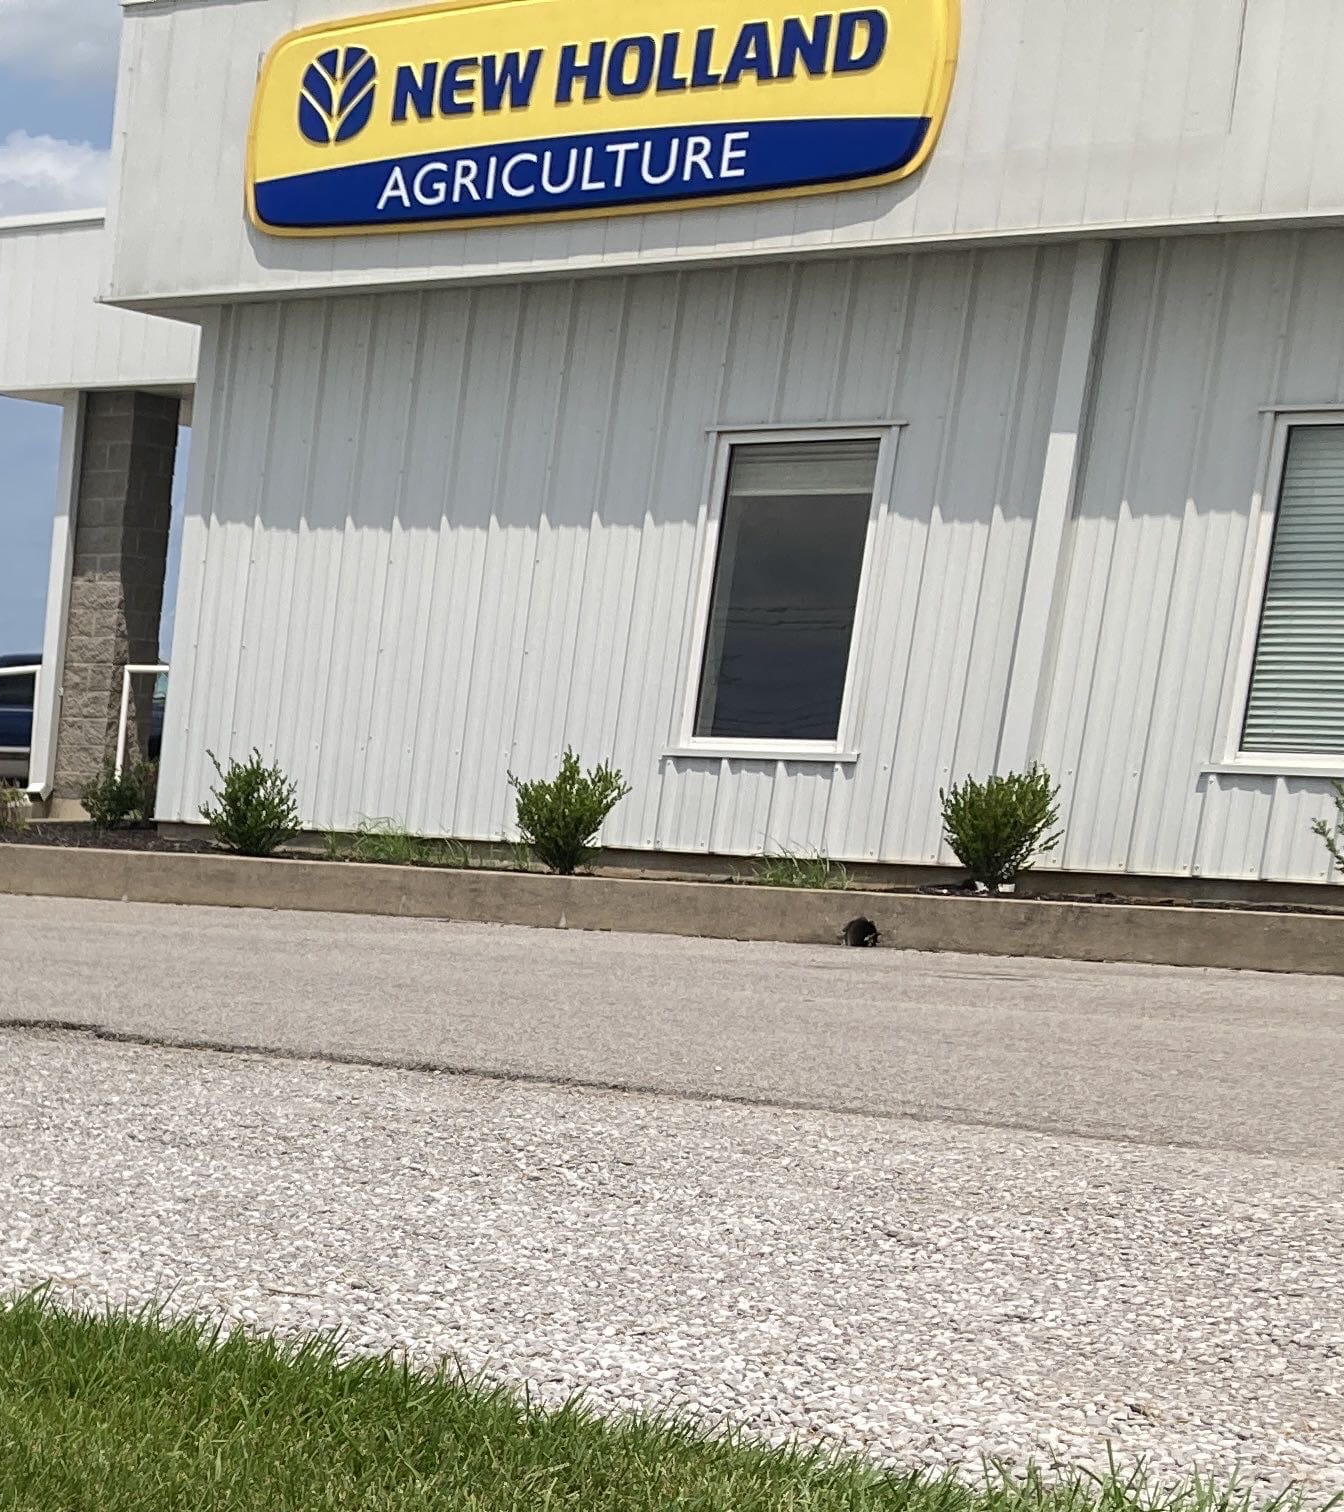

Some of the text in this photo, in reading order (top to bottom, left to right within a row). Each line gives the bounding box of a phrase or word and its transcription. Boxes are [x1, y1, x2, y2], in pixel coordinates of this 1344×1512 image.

[391, 8, 889, 123] NEW HOLLAND
[376, 131, 750, 211] AGRICULTURE
